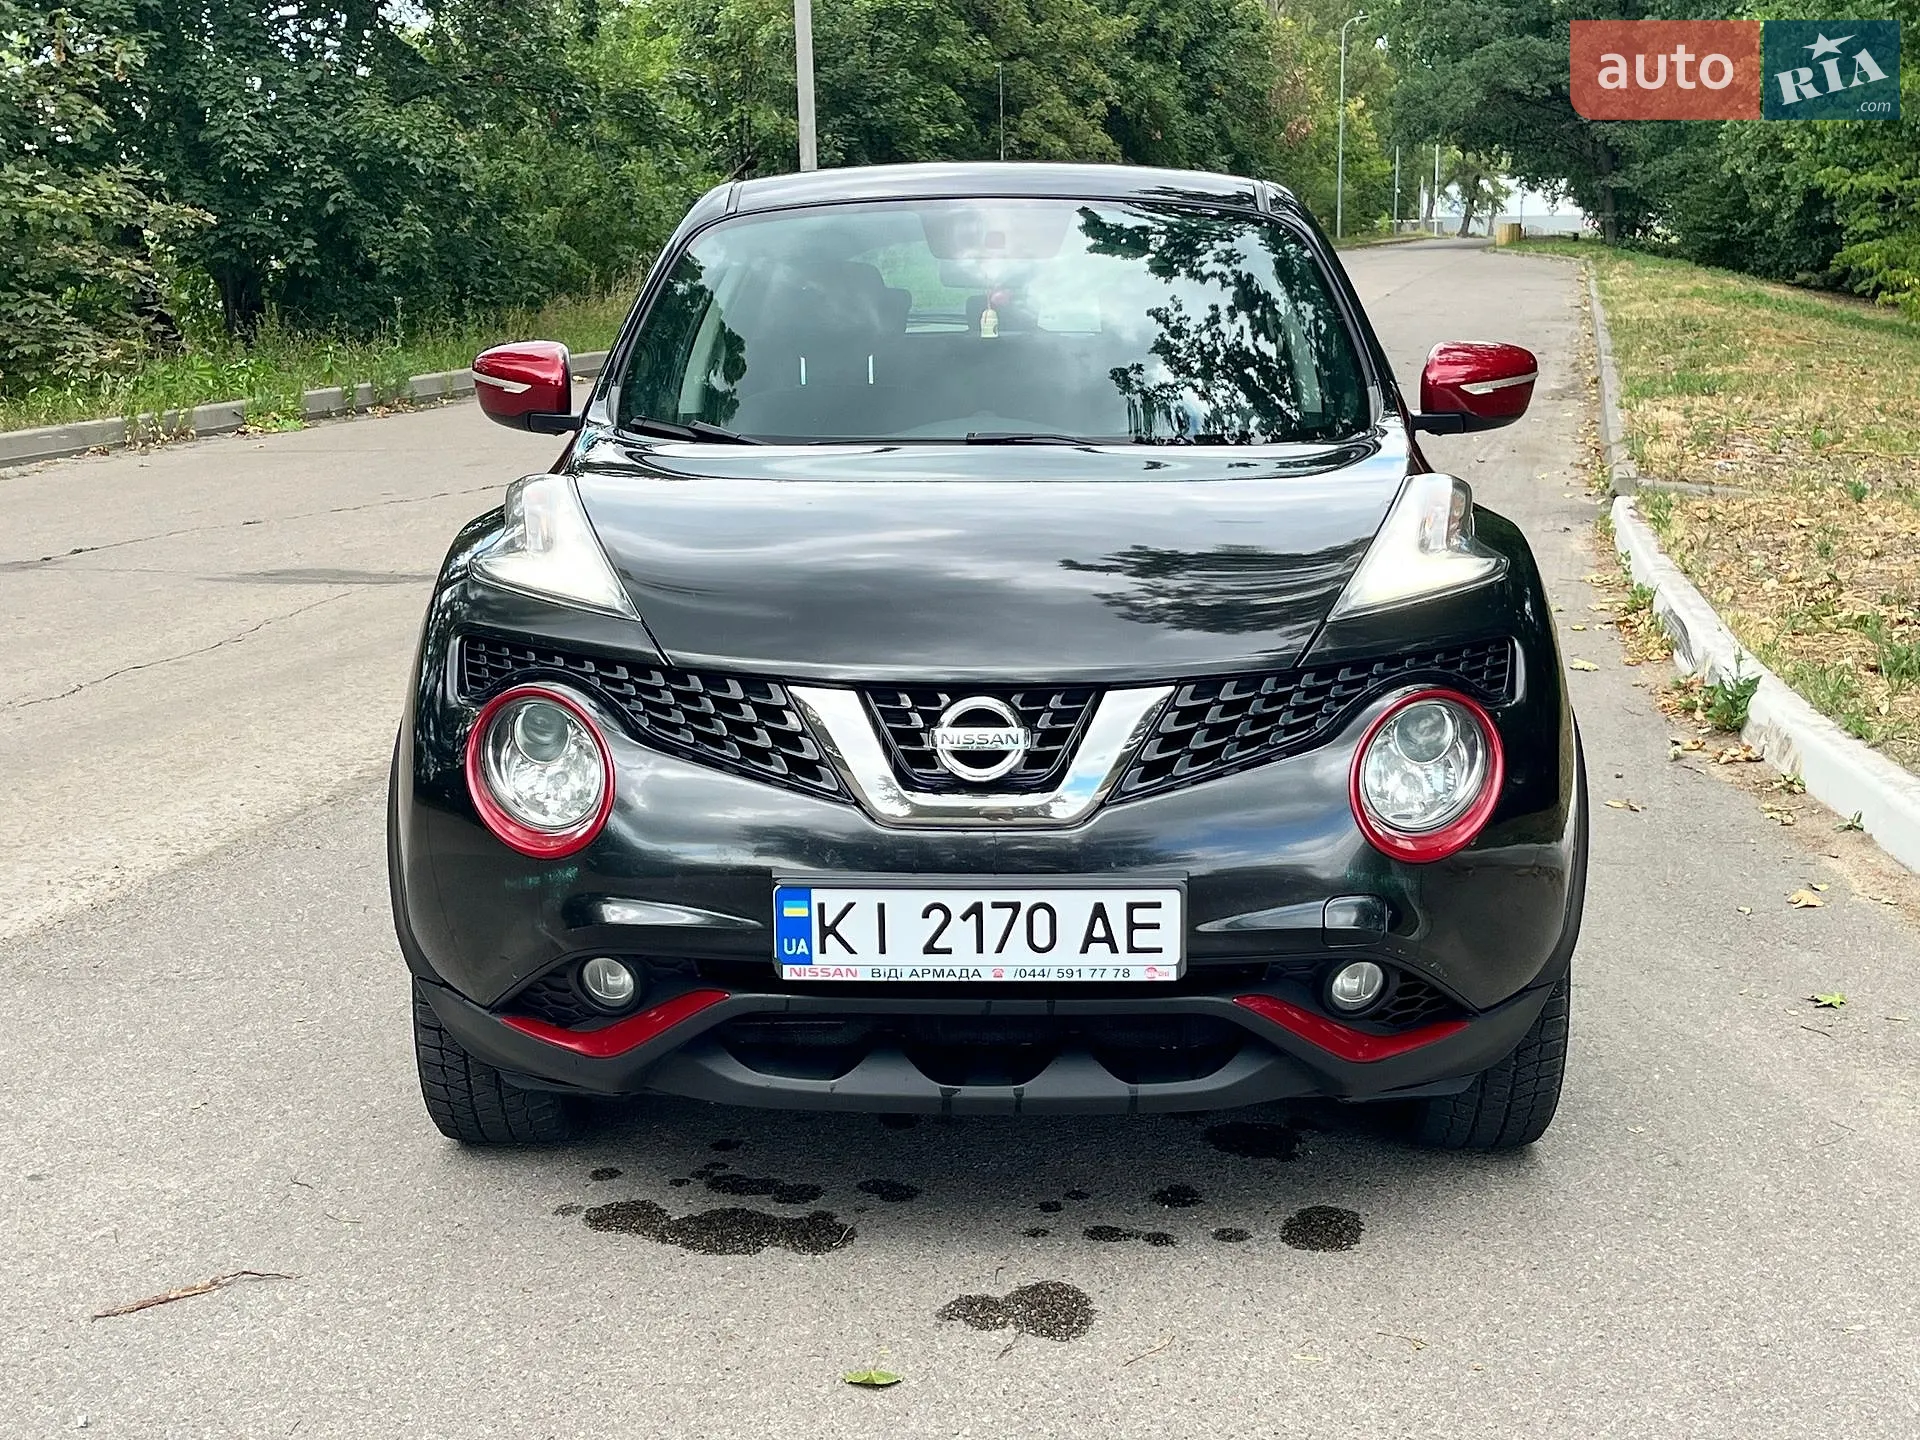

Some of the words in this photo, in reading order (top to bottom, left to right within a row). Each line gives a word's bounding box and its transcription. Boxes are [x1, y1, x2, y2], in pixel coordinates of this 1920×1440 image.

[940, 733, 1019, 745] NISSAN
[922, 901, 1057, 955] 2170
[1079, 901, 1164, 955] AE
[783, 938, 810, 955] UA
[789, 967, 858, 978] NISSAN
[908, 967, 982, 980] АРМАДА
[1014, 967, 1051, 979] /044/
[1056, 968, 1082, 979] 591
[1089, 968, 1107, 979] 77
[1113, 968, 1131, 979] 78
